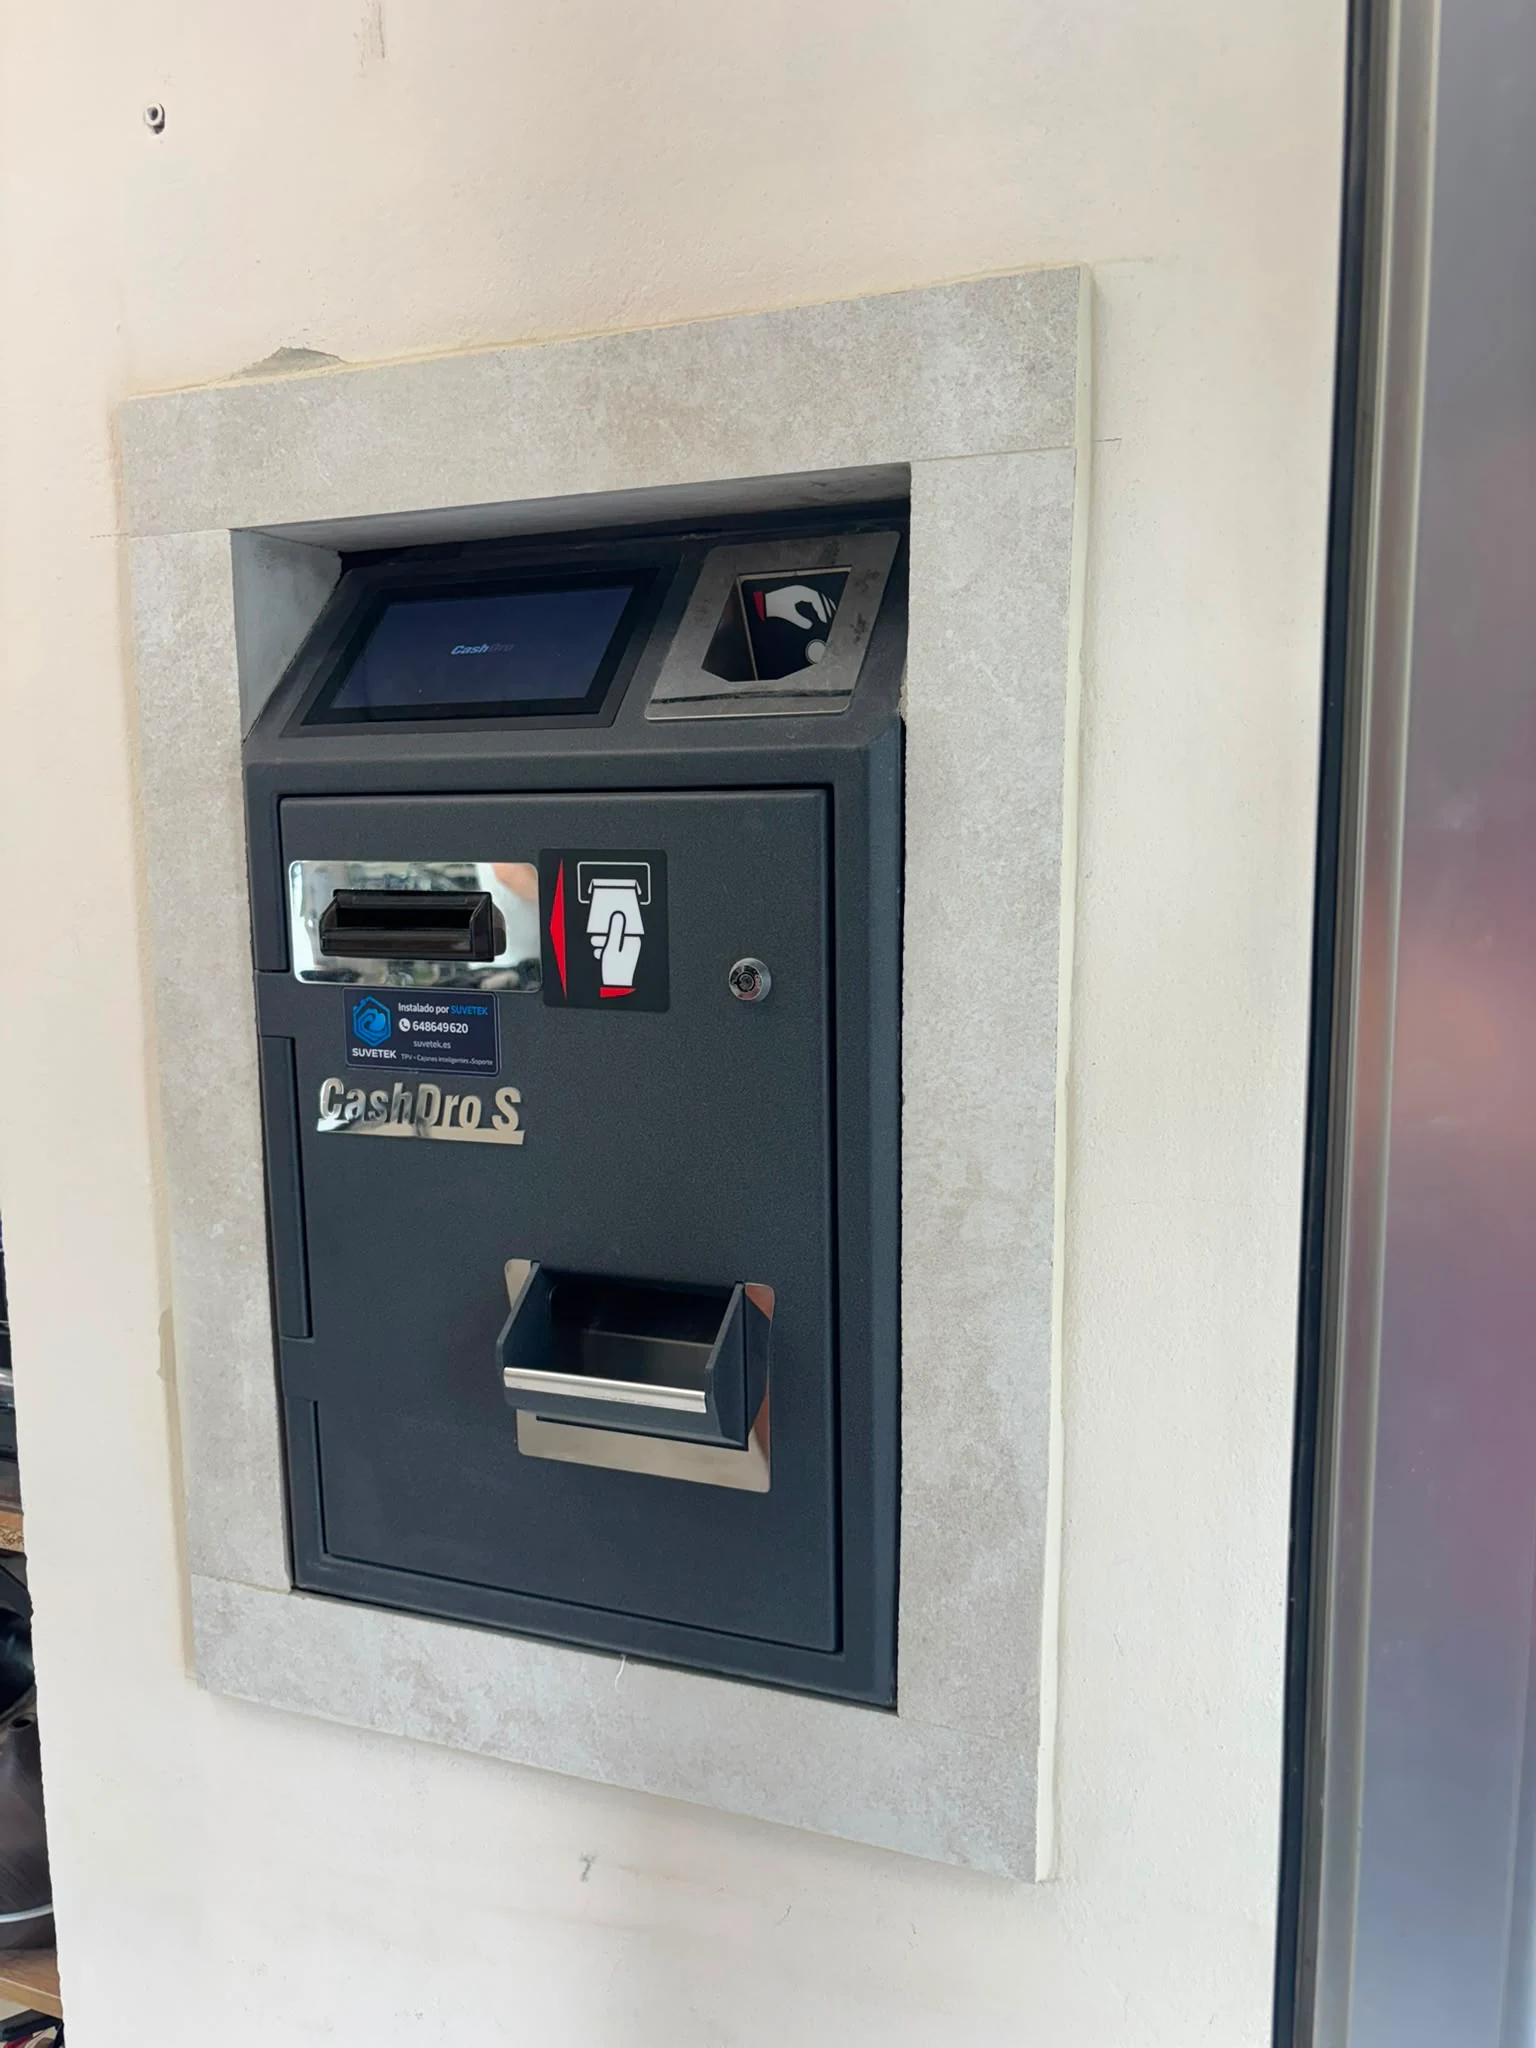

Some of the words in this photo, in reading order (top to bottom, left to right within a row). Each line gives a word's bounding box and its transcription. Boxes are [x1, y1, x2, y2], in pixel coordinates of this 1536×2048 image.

[398, 1002, 434, 1014] Instalado
[435, 1005, 450, 1015] por
[450, 1006, 488, 1015] SUVETEK
[412, 1021, 469, 1033] 648649620
[413, 1040, 452, 1049] suvetek.es
[352, 1048, 396, 1059] SUVETEK
[319, 1077, 482, 1130] CashDro
